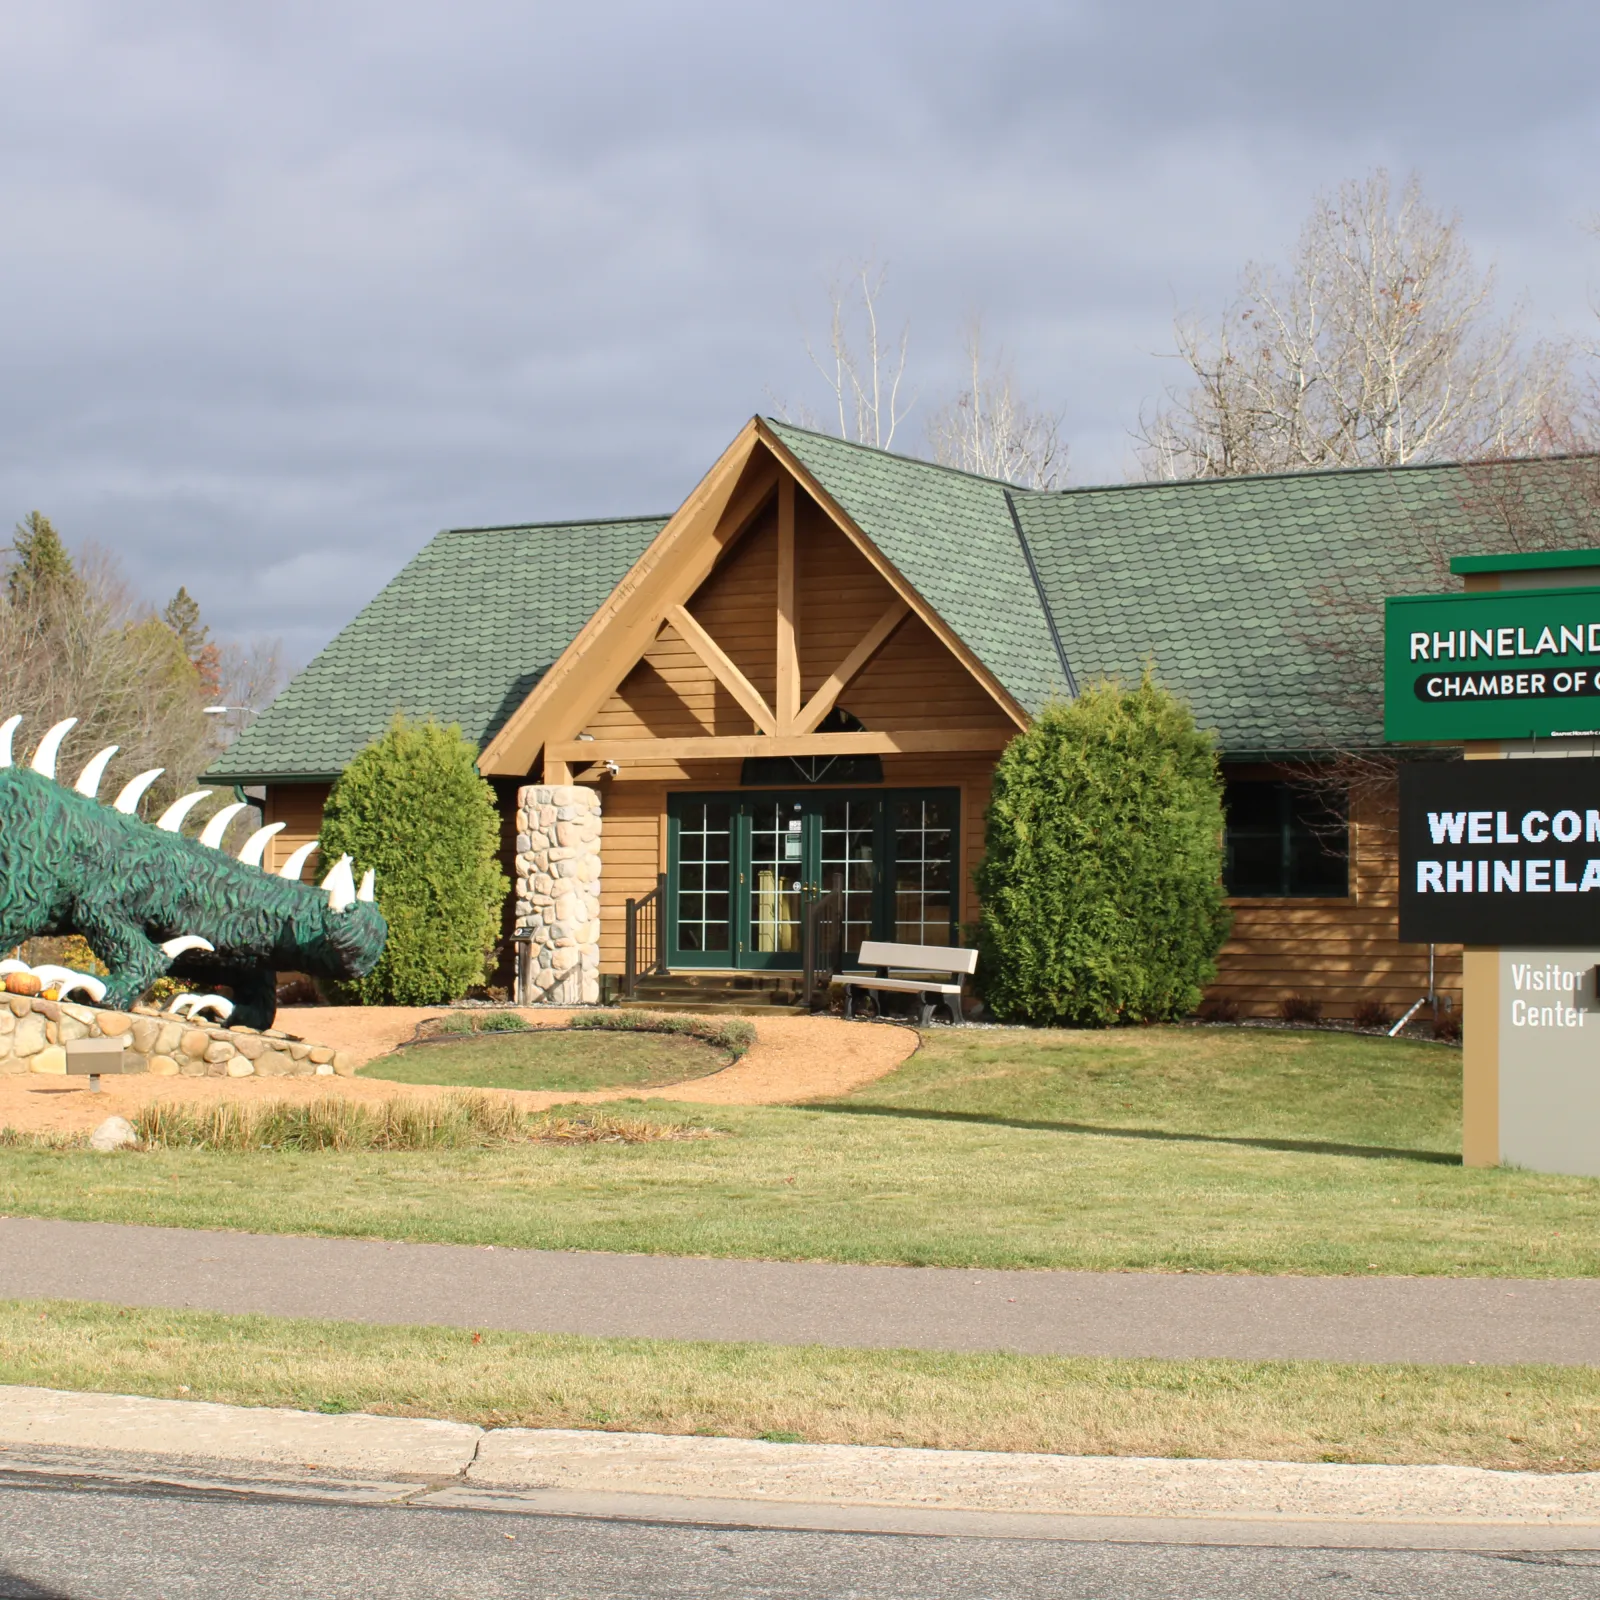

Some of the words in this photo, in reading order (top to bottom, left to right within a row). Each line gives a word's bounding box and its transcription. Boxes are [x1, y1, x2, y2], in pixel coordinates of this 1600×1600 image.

[1426, 673, 1546, 697] CHAMBER
[1553, 671, 1587, 692] OF
[1416, 859, 1600, 893] RHINELA
[1511, 963, 1586, 991] Visitor
[1512, 999, 1588, 1027] Center
